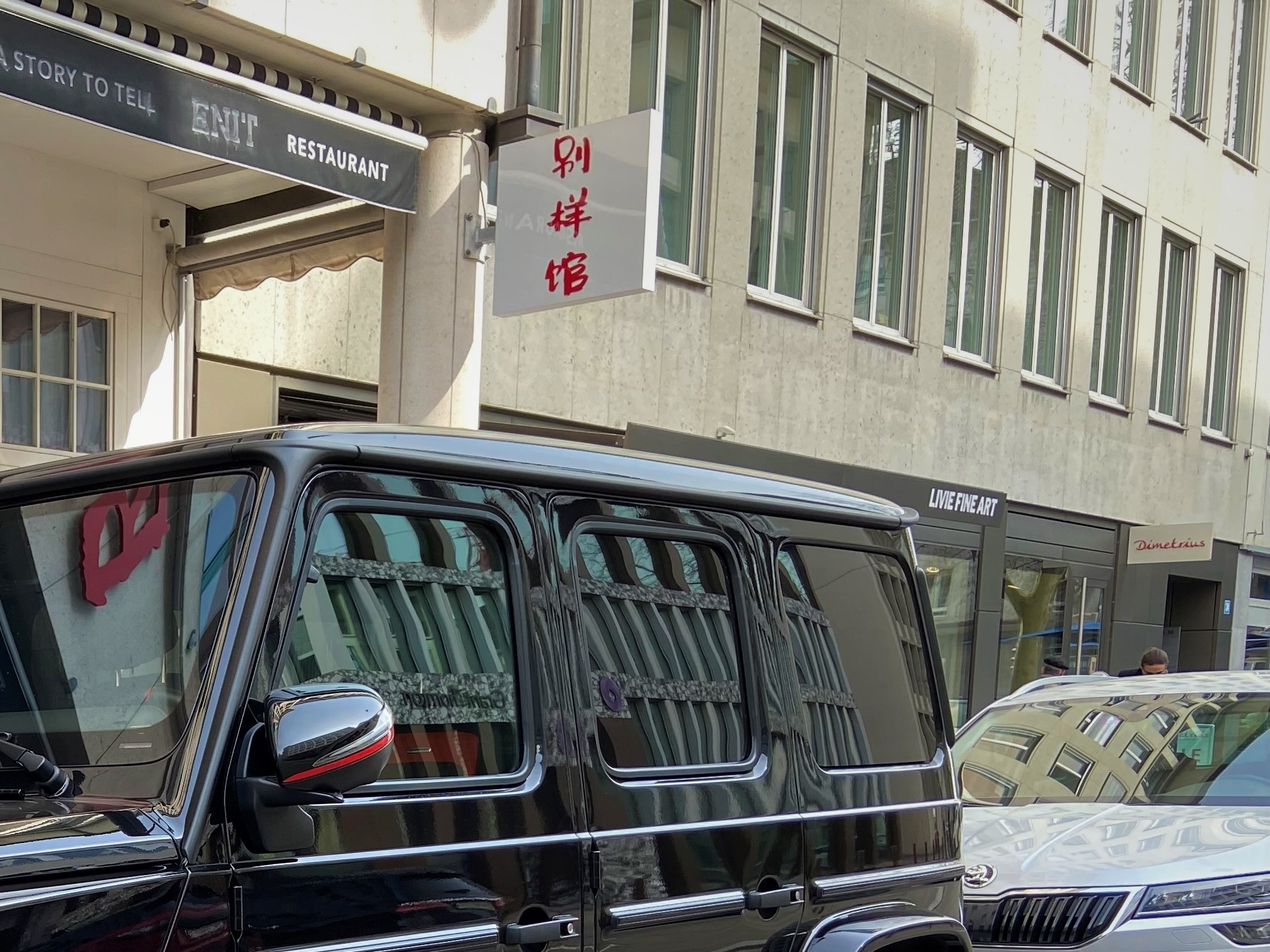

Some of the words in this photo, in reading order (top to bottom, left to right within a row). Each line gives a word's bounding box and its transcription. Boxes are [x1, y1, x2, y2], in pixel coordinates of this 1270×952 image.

[14, 51, 77, 87] STORY
[83, 72, 109, 97] TO
[191, 97, 259, 148] ENIT
[287, 133, 389, 181] RESTAURANT
[928, 488, 956, 511] LIVIE
[954, 492, 978, 514] FINE
[976, 496, 998, 517] ART
[1134, 538, 1205, 551] Dimetrius
